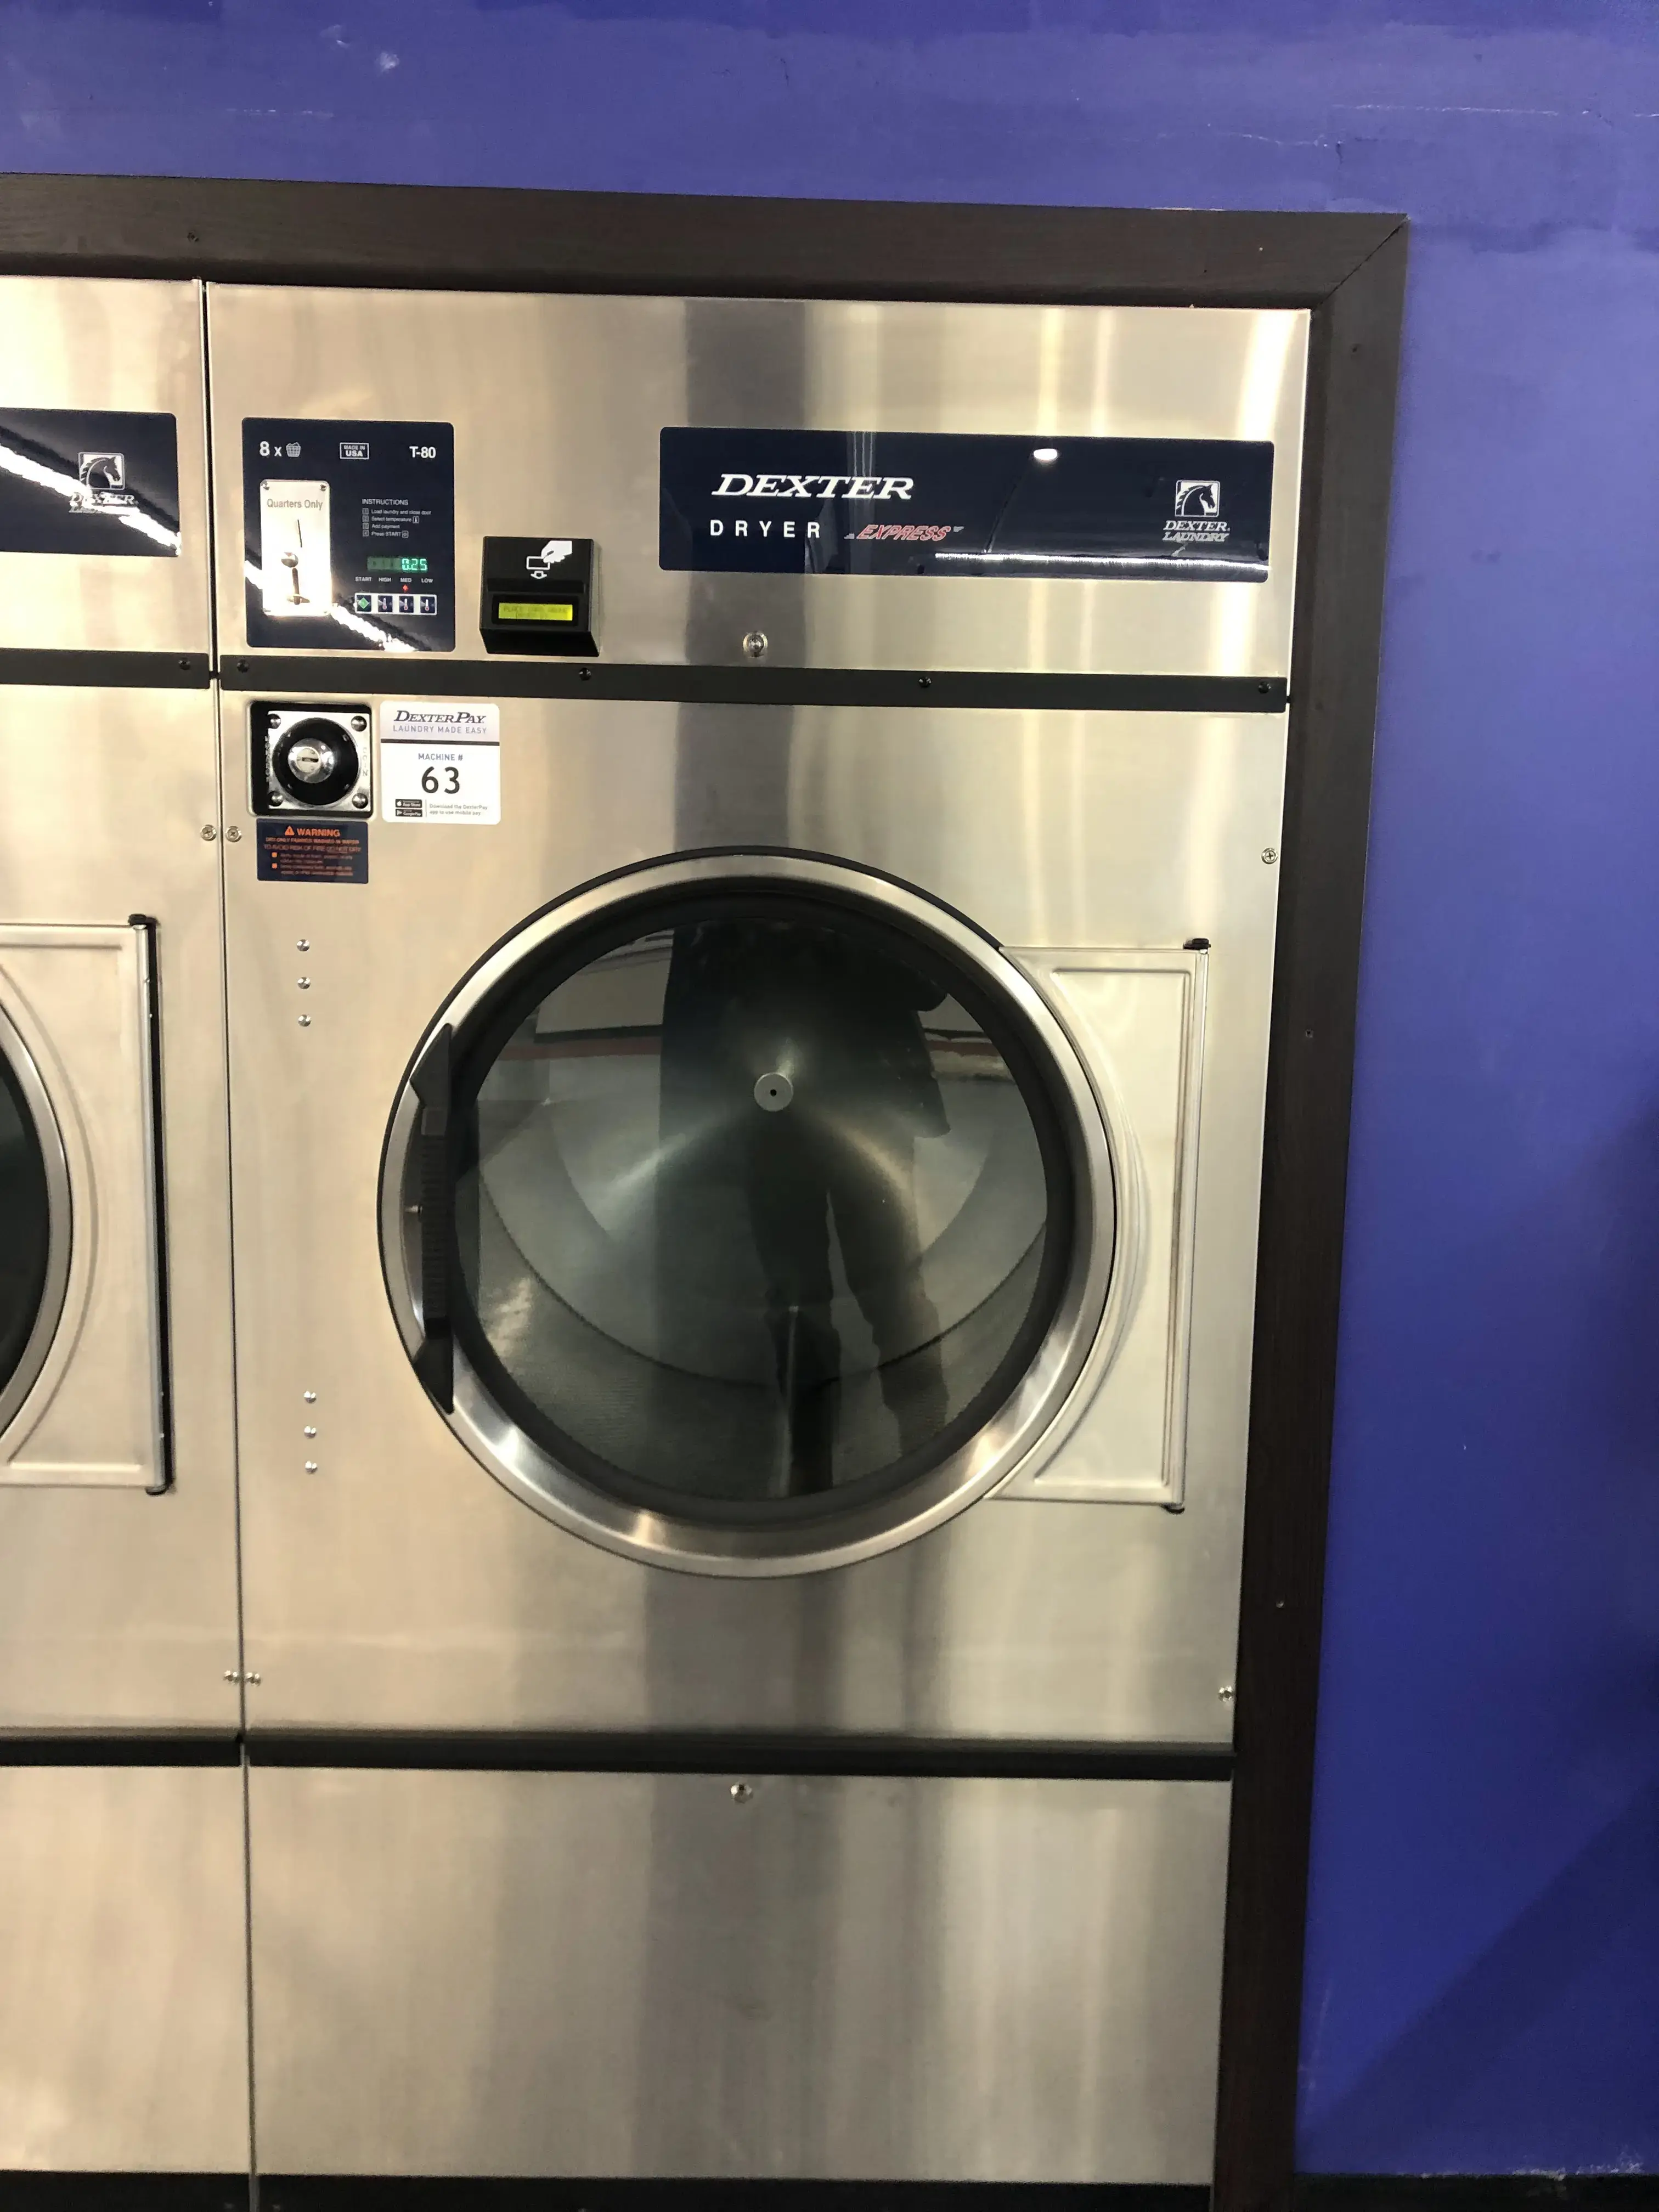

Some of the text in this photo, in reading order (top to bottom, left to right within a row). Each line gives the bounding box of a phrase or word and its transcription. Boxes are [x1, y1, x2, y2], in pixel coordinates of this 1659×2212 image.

[259, 441, 283, 457] 8 x
[409, 446, 436, 459] T-80
[711, 473, 915, 500] DEXTER
[267, 499, 323, 511] Quarters Only
[710, 520, 952, 541] DRYER EXPRESS
[1163, 520, 1228, 532] DEXTER
[1162, 532, 1230, 542] LAUNDRY
[393, 725, 434, 733] LAUNDRY
[421, 766, 460, 794] 63
[297, 828, 341, 837] WARNING
